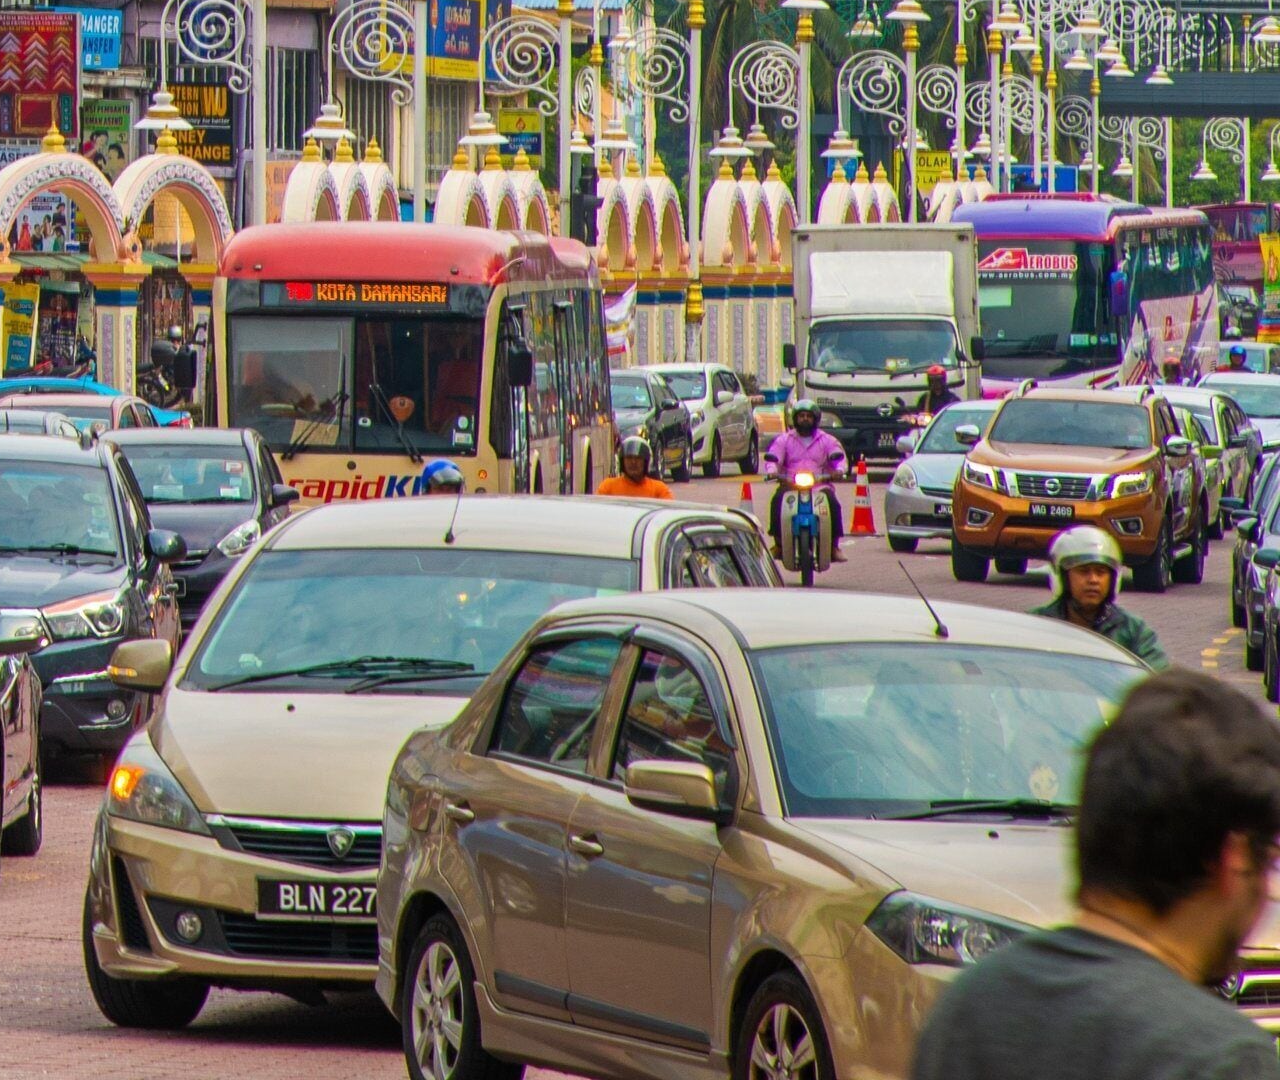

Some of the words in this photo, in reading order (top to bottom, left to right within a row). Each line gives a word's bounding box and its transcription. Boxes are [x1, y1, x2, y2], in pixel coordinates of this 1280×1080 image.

[81, 15, 120, 35] HANGER
[83, 36, 114, 54] ANSFER
[173, 130, 206, 144] ONEY
[316, 283, 357, 301] KOTA
[279, 884, 326, 913] BLN
